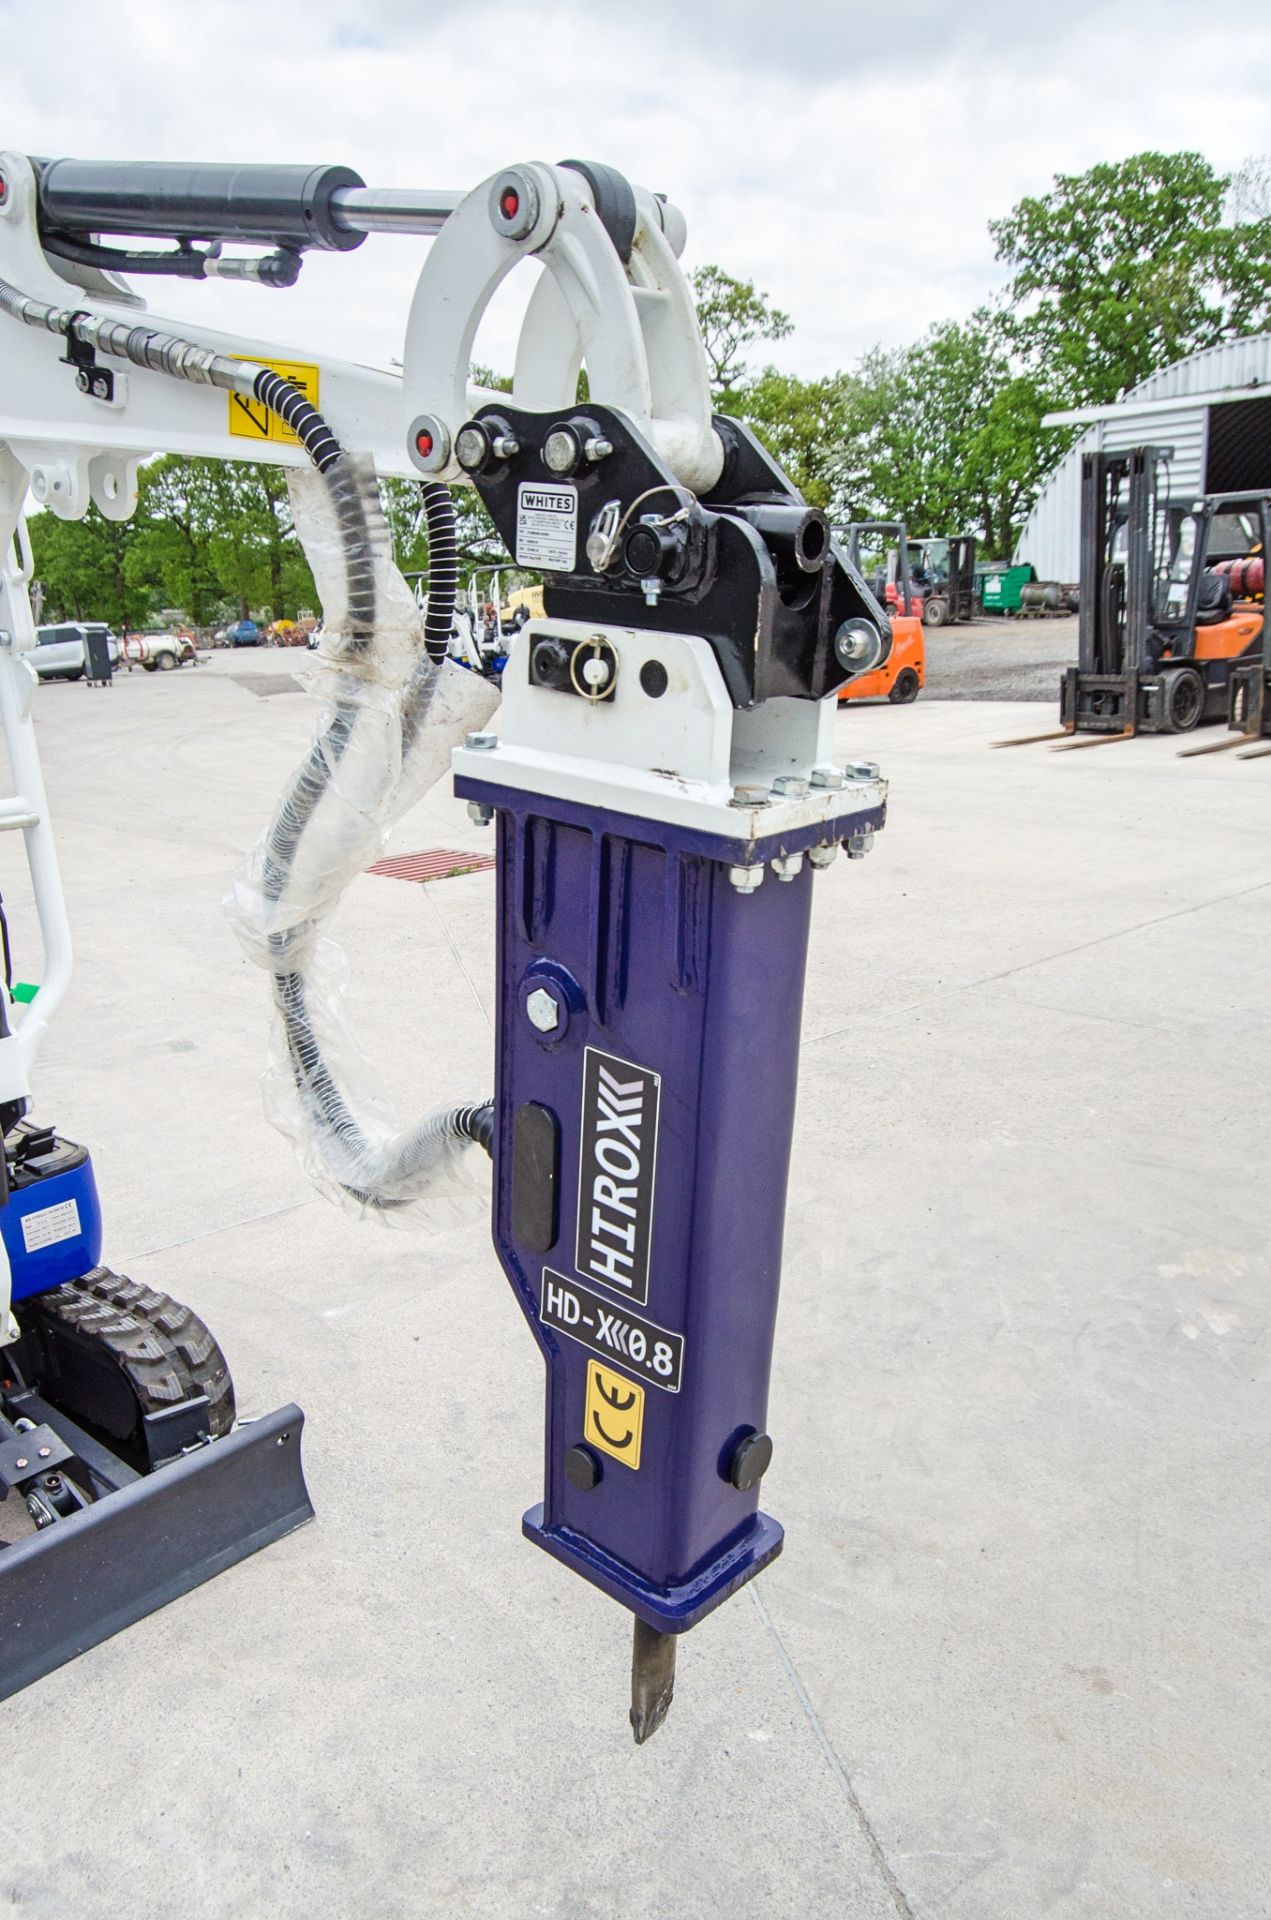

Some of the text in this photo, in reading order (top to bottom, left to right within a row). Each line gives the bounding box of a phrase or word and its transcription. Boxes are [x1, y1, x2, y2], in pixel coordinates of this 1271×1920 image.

[525, 494, 570, 510] WHITES
[589, 1097, 643, 1289] HIROX
[593, 1372, 636, 1449] CE
